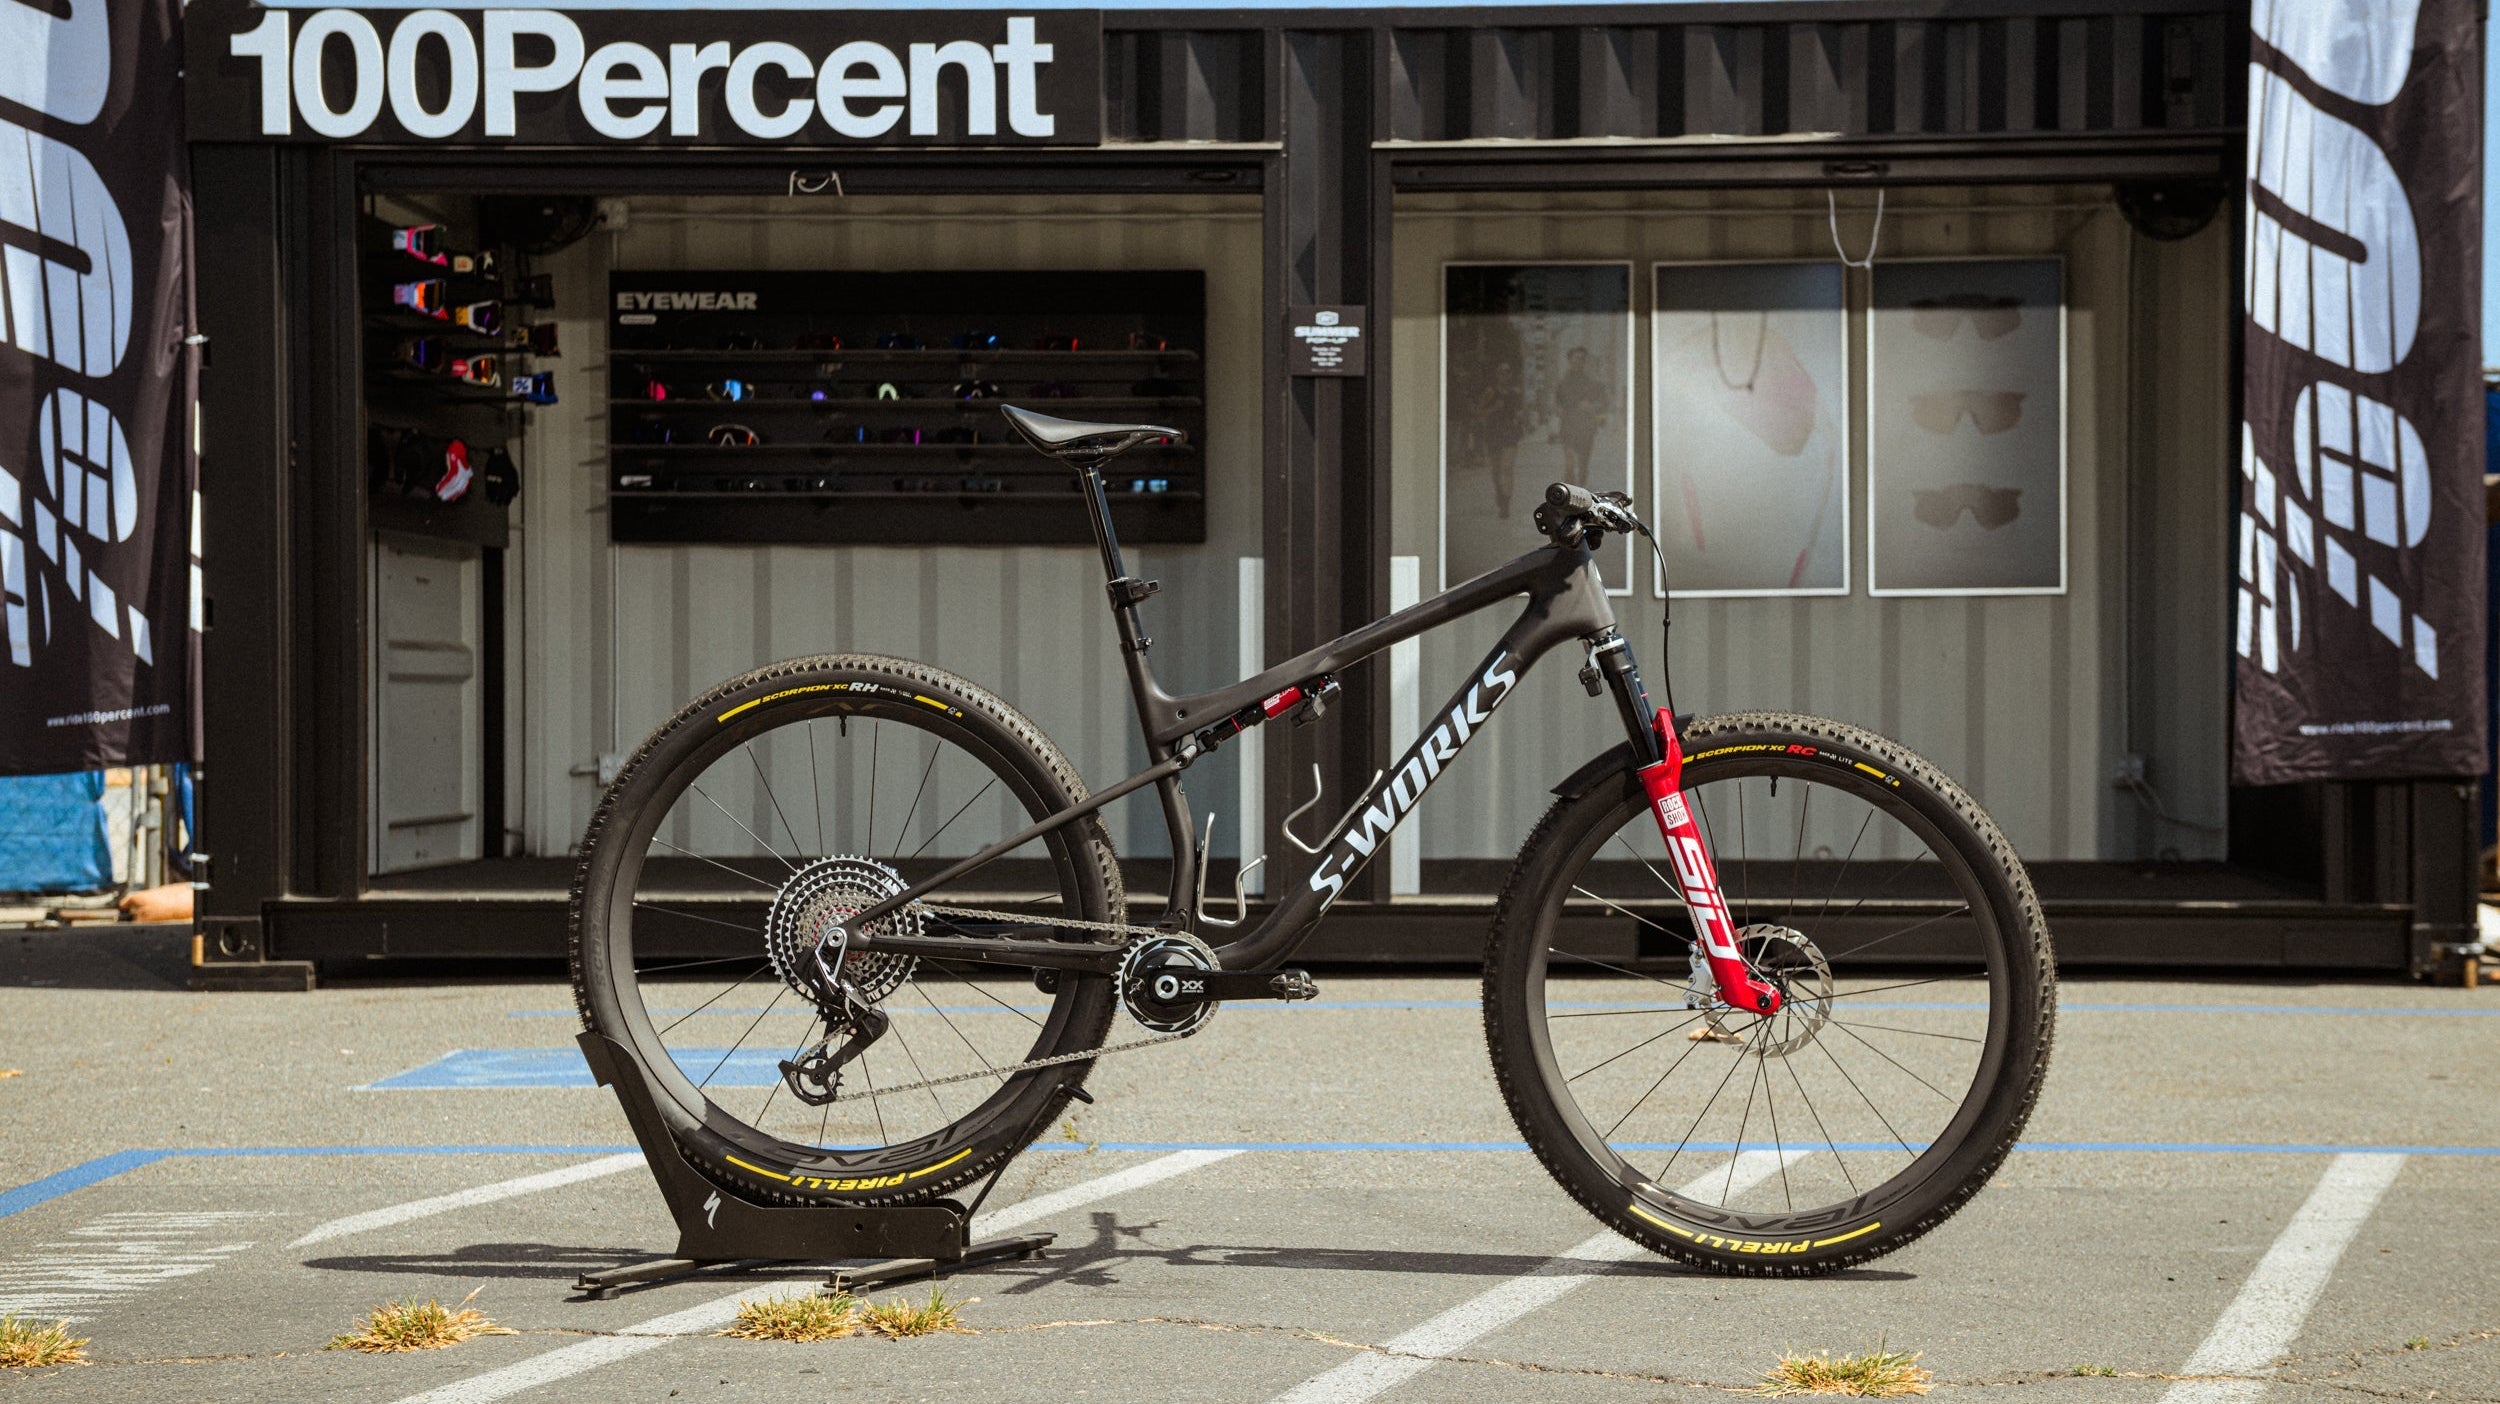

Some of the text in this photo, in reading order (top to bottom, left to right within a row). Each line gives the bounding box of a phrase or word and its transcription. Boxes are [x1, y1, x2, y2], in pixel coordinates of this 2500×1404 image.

[230, 8, 1055, 139] 100Percent
[616, 291, 758, 311] EYEWEAR
[760, 684, 830, 703] SCORPION
[849, 681, 879, 694] RH
[46, 703, 171, 727] www.ride100percent.com
[1696, 744, 1770, 760] SCORPION
[1786, 744, 1818, 757] RC
[1310, 650, 1517, 913] S-WORKS
[1661, 796, 1683, 812] ROCK
[791, 1171, 908, 1192] PIRELLI
[1694, 1233, 1811, 1255] PIRELLI
